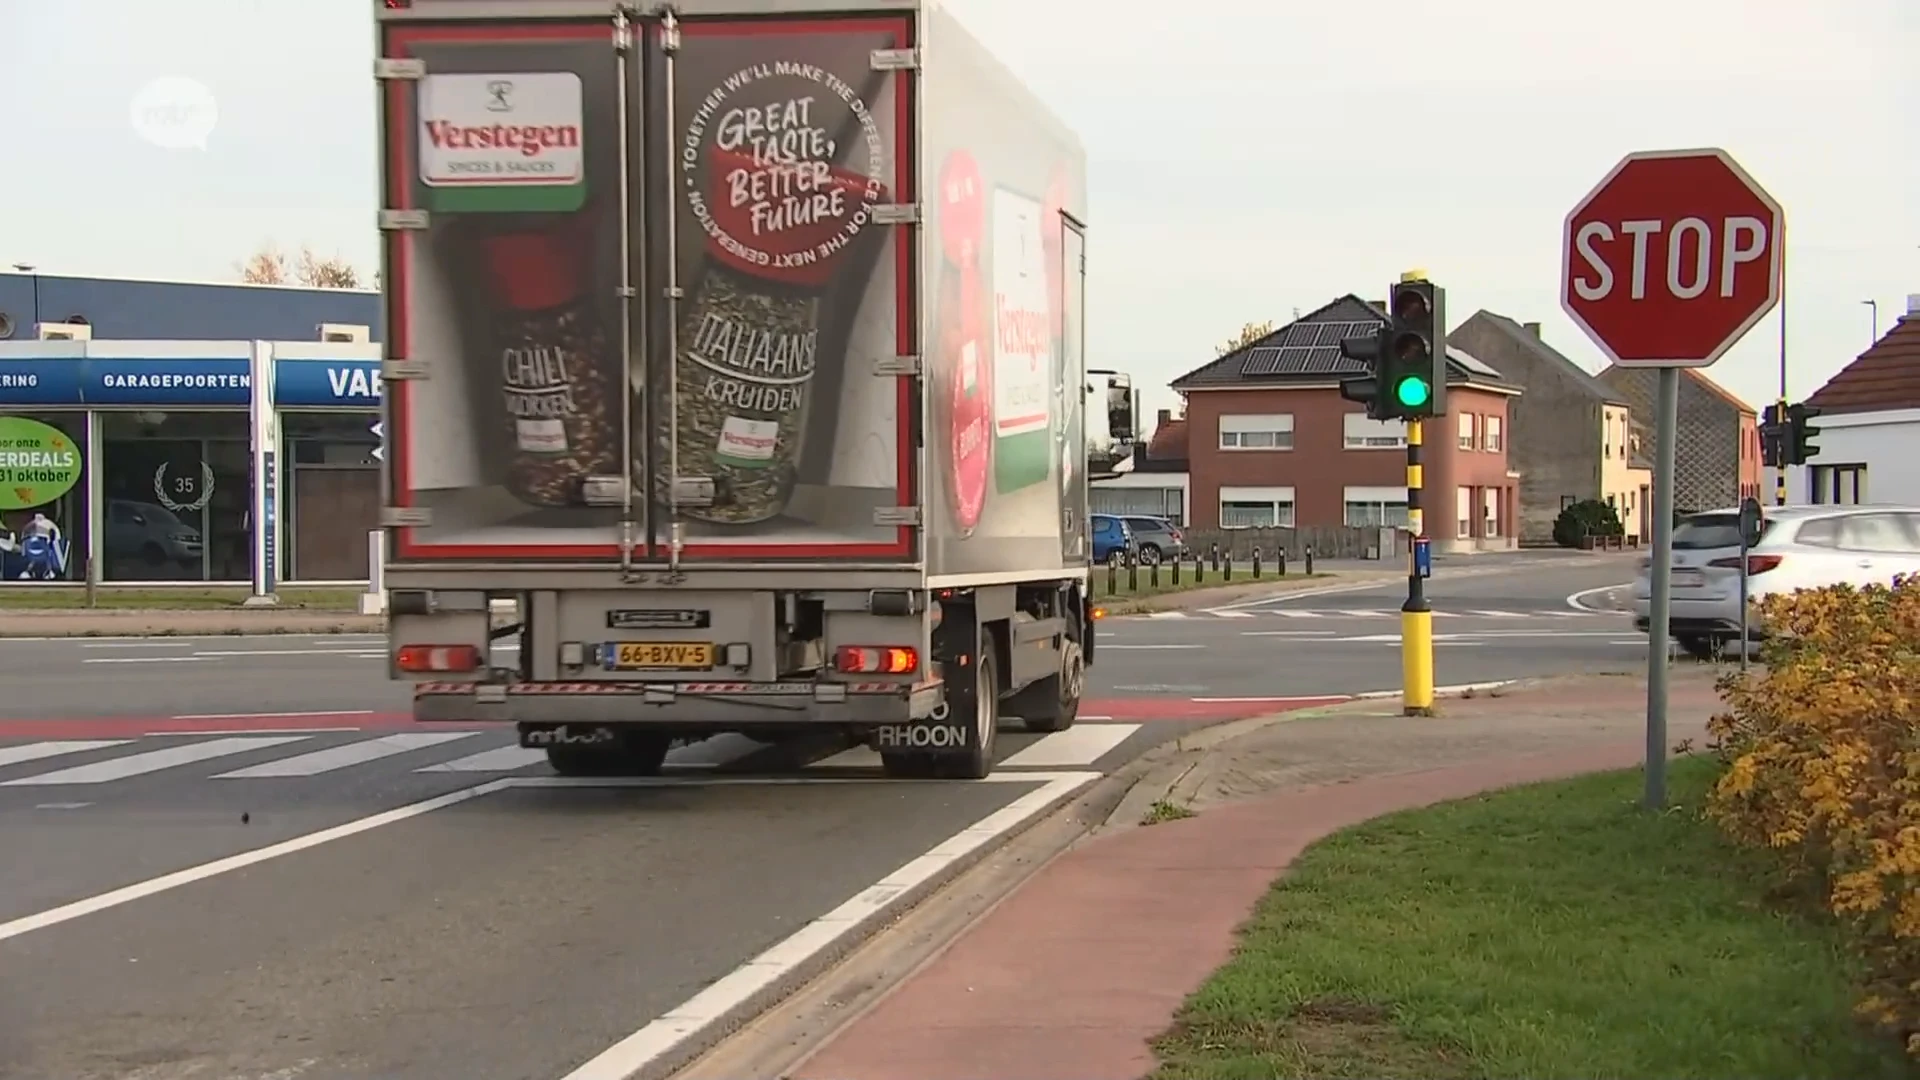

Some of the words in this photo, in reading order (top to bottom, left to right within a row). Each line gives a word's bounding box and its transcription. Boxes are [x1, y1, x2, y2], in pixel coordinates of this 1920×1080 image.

[724, 63, 772, 92] WE'LL
[775, 61, 824, 82] MAKE
[825, 73, 855, 101] THE
[425, 119, 579, 157] Verstegen
[683, 88, 727, 172] TOGETHER
[716, 97, 815, 151] GREAT
[750, 128, 836, 167] TASTE,
[851, 99, 884, 200] DIFFERENCE
[725, 160, 834, 208] BETTER
[688, 191, 770, 266] GENERATION
[749, 187, 847, 236] FUTURE
[846, 201, 872, 236] FOR
[772, 250, 817, 268] NEXT
[821, 232, 850, 257] THE
[1573, 217, 1767, 301] STOP
[694, 312, 818, 374] ITALIAANS
[0, 374, 38, 387] RING
[104, 373, 250, 388] GARAGEPOORTEN
[503, 346, 568, 386] CHILI
[704, 375, 802, 411] KRUIDEN
[16, 440, 40, 448] onze
[17, 470, 71, 482] oktober
[175, 478, 194, 493] 35
[620, 646, 705, 663] 66-BXV-5
[879, 726, 967, 747] RHOON
